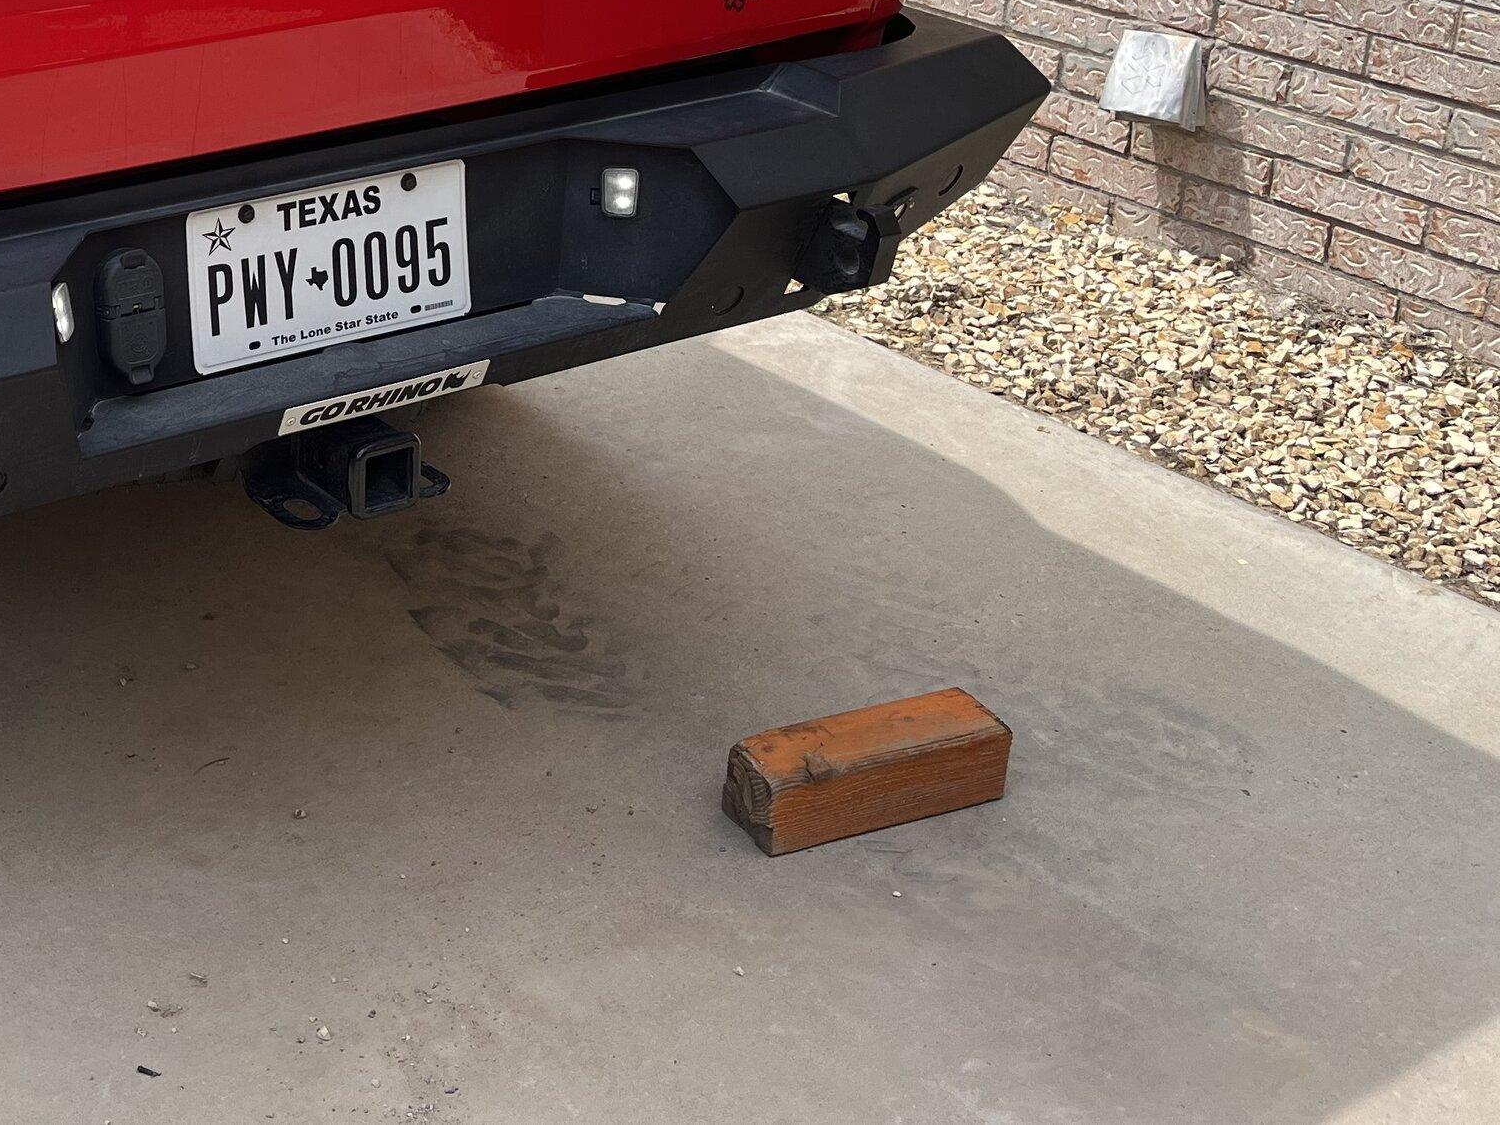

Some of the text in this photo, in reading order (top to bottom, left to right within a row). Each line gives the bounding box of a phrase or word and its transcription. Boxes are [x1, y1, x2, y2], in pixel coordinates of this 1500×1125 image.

[276, 185, 382, 232] TEXAS
[207, 216, 452, 338] PWY 0095
[271, 309, 399, 346] The Lone Star State
